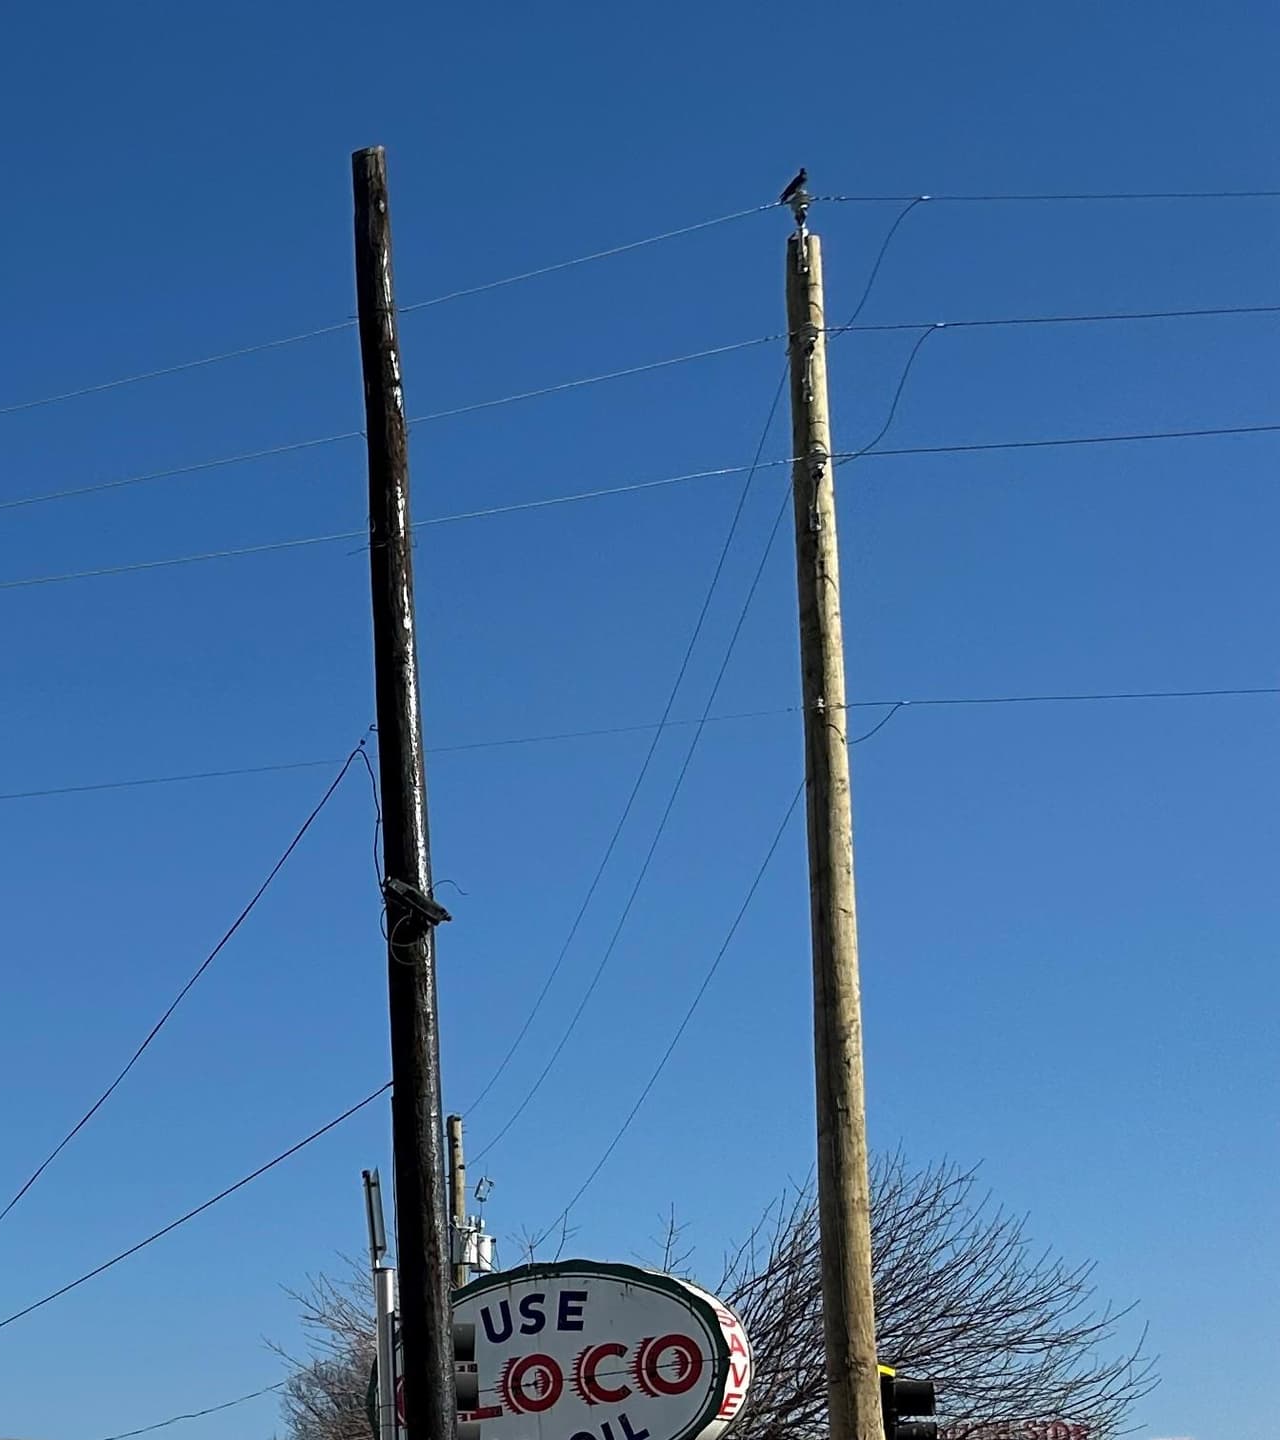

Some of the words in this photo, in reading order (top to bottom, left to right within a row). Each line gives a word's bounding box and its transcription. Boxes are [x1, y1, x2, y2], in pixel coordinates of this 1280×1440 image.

[480, 1291, 588, 1343] USE
[715, 1308, 748, 1416] SAVE
[397, 1334, 702, 1427] LOCO
